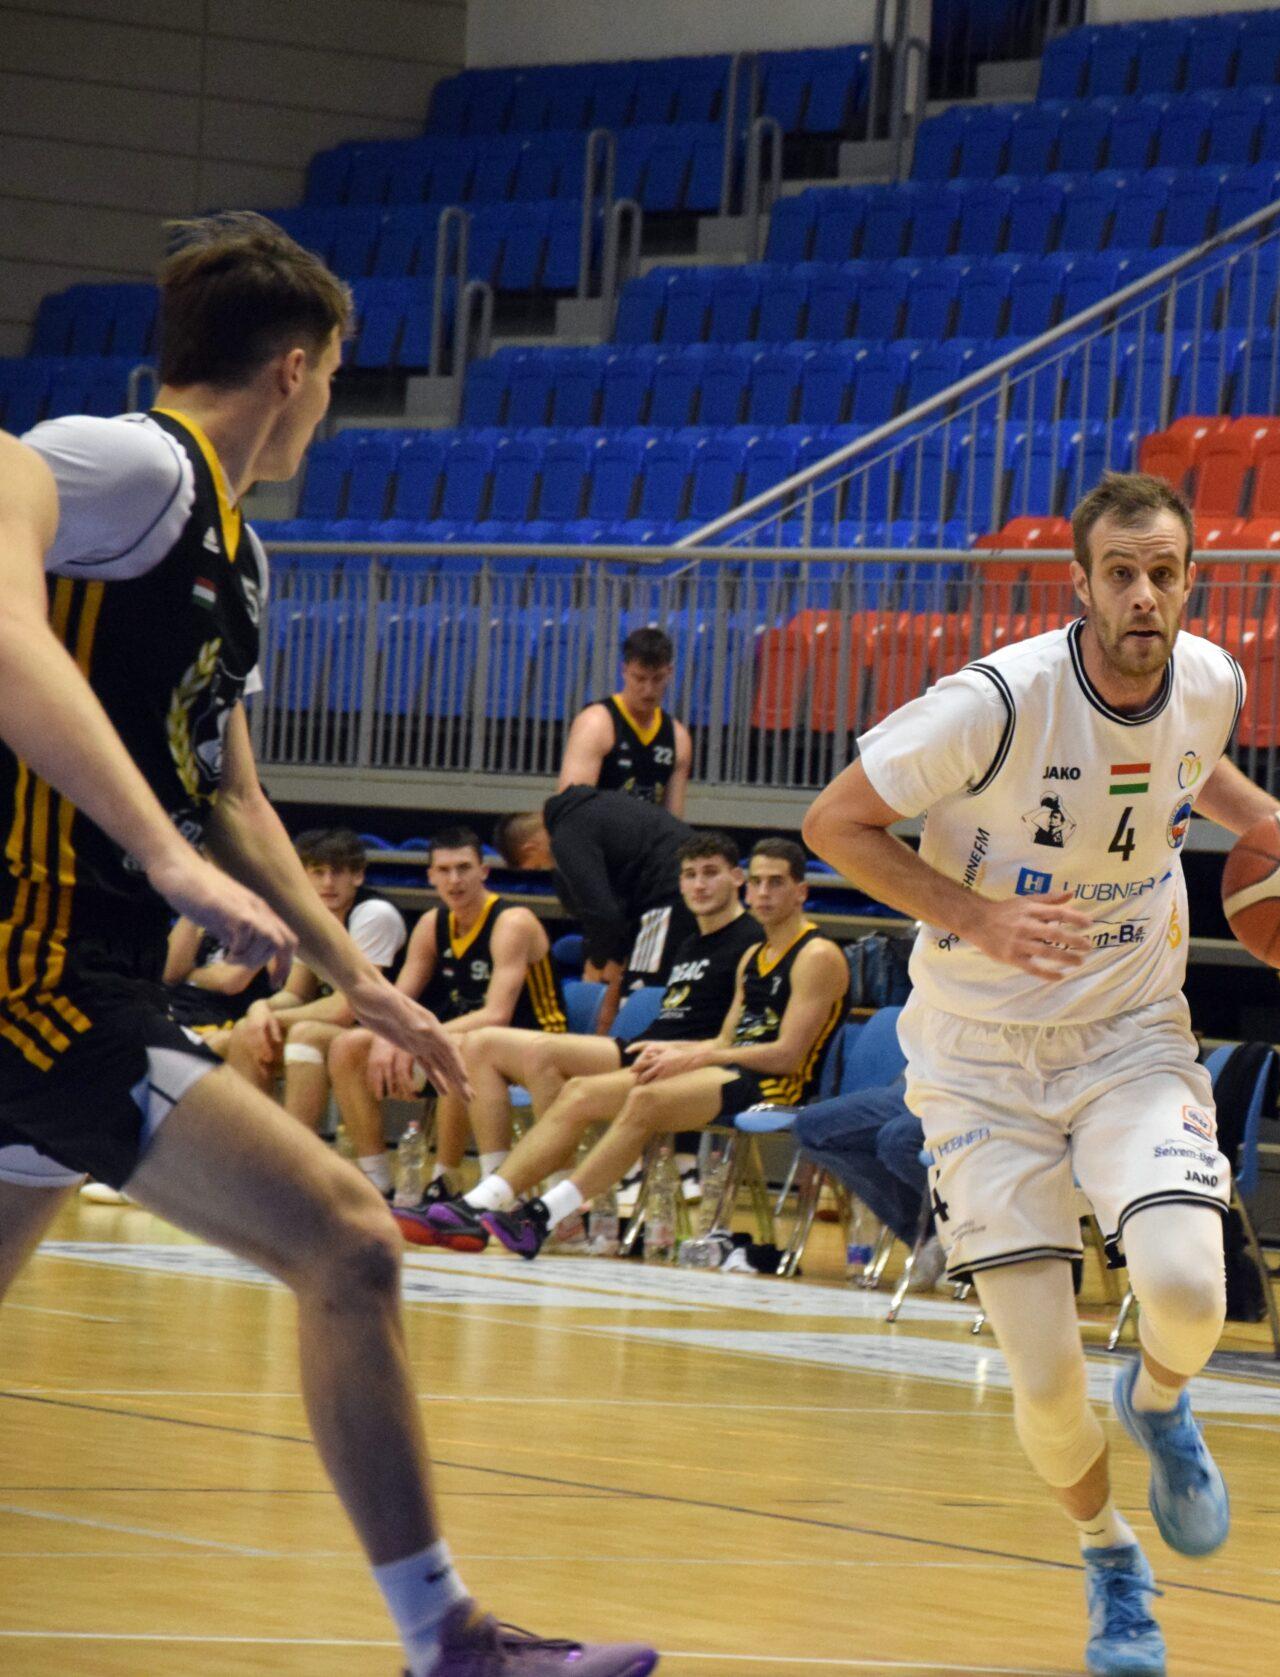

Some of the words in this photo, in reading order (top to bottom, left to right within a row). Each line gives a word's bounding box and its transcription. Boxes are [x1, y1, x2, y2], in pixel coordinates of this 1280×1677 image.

[654, 745, 673, 766] 22
[1042, 766, 1081, 781] JAKO
[1107, 806, 1136, 862] 4
[1184, 1170, 1219, 1188] JAKO
